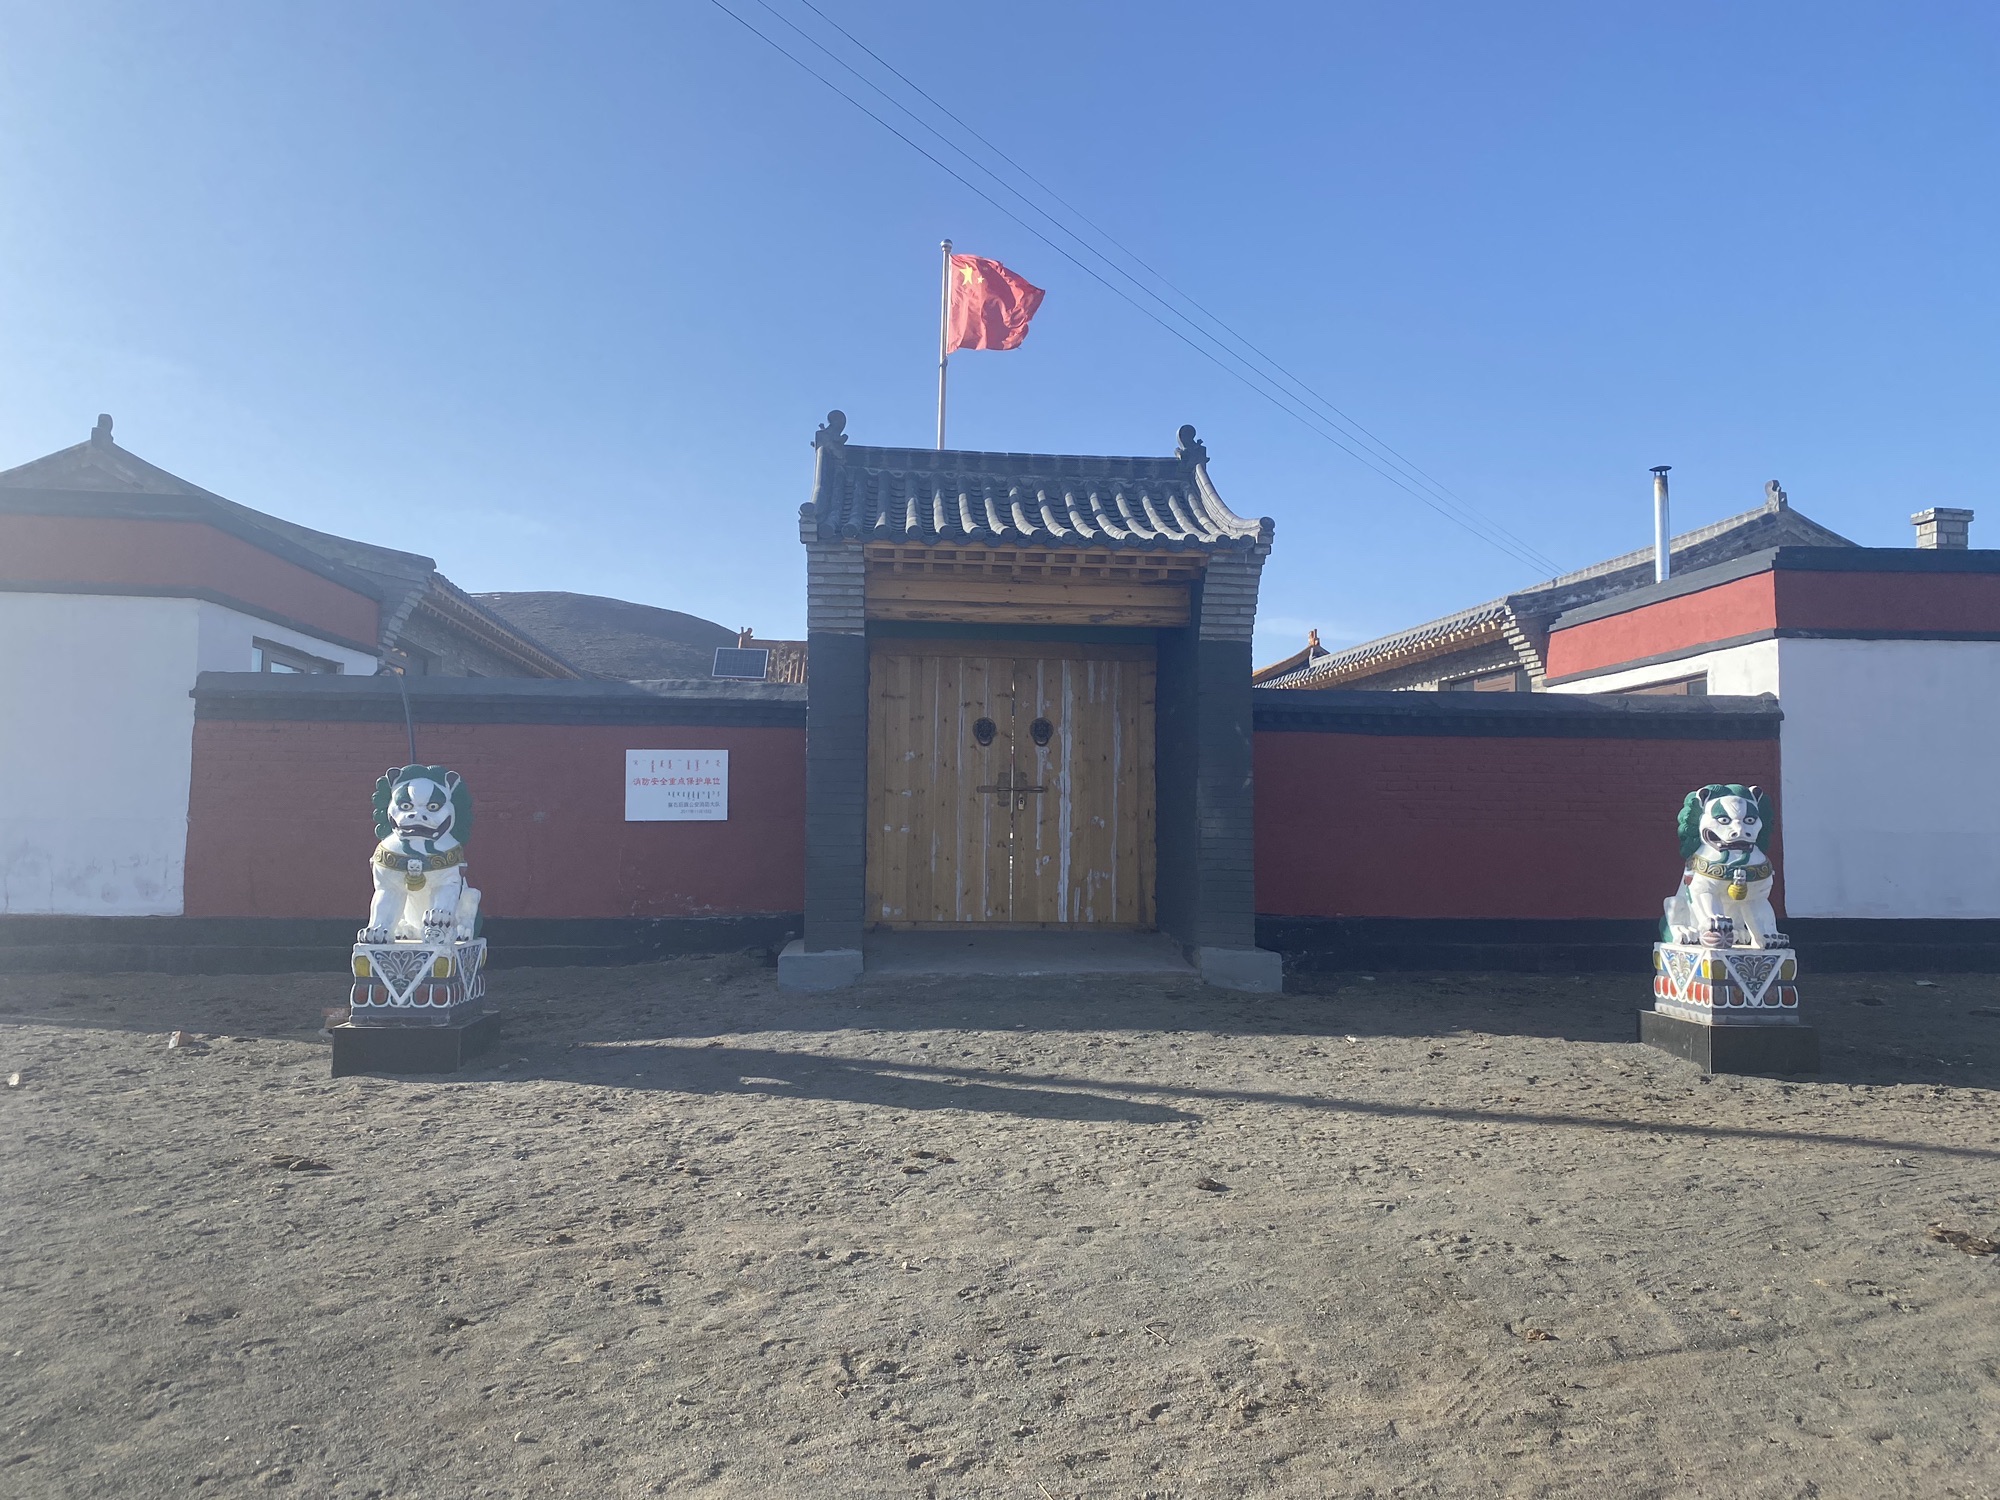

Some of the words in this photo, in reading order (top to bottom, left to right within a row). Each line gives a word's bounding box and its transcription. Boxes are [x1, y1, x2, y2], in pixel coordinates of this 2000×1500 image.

[633, 777, 721, 786] 消防安全重点保护单位
